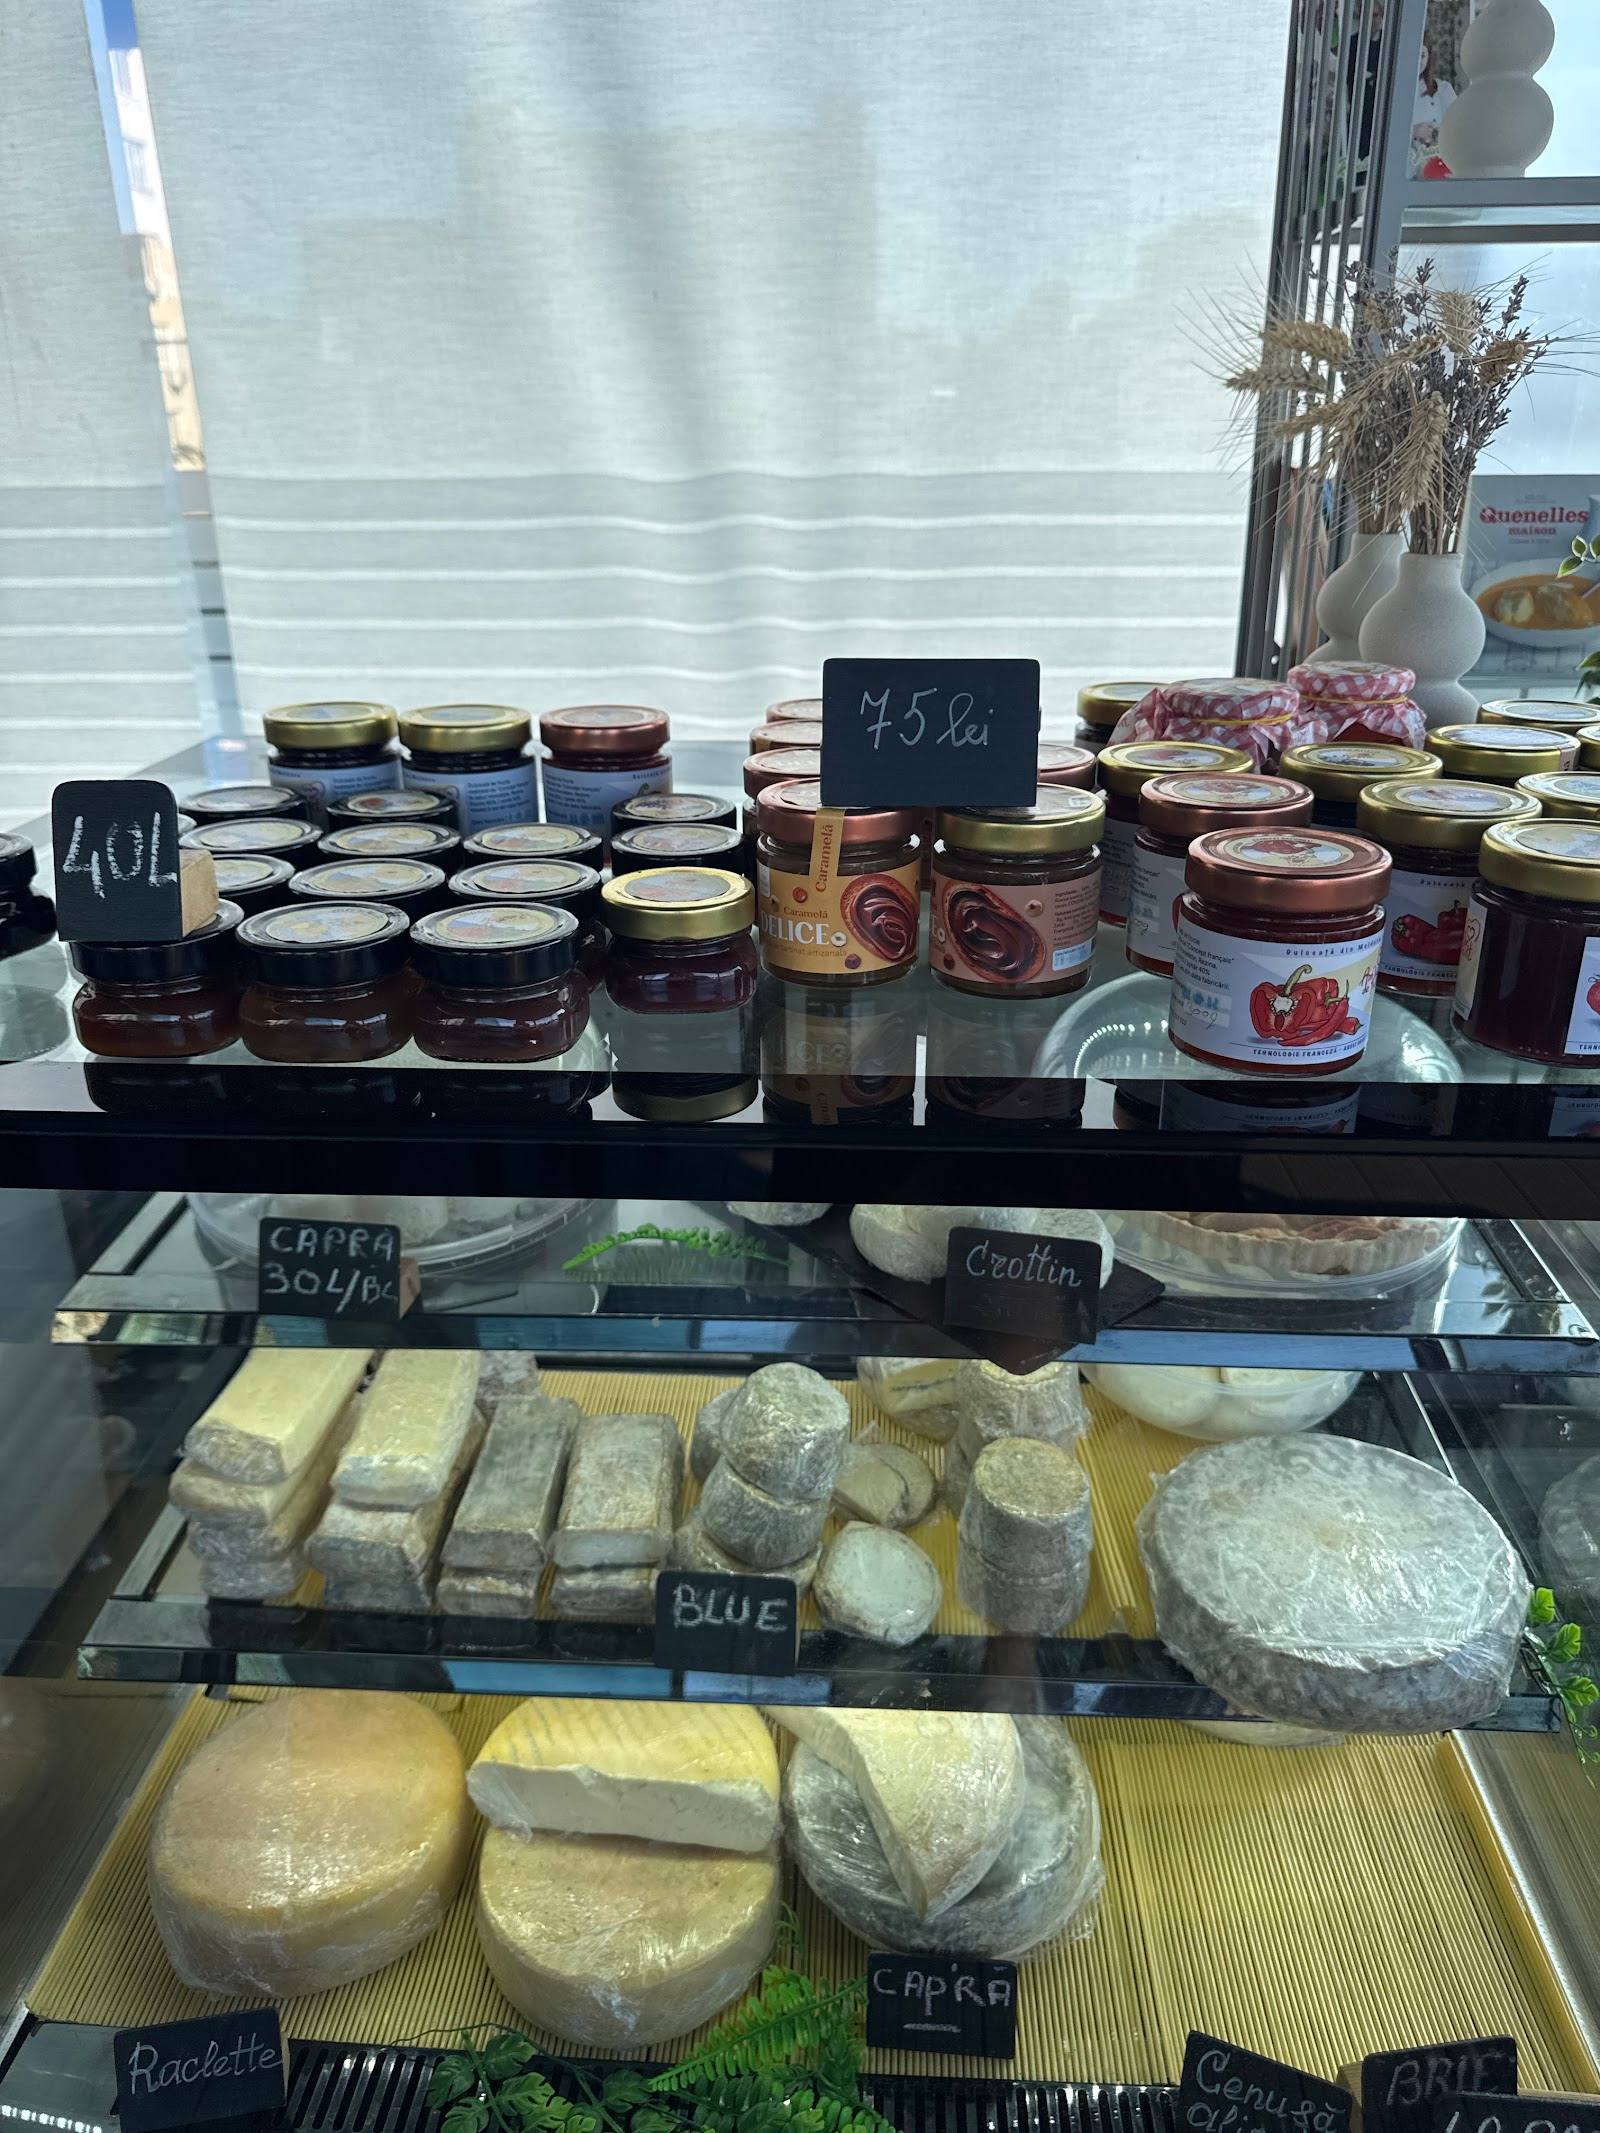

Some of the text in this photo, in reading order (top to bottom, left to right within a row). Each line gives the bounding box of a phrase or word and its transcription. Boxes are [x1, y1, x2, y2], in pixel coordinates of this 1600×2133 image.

[1480, 506, 1589, 523] Quenelles
[1508, 526, 1557, 535] maison
[860, 687, 994, 750] 75 lei
[815, 823, 834, 893] Caramelă
[783, 906, 828, 919] Caramelă
[1253, 1048, 1300, 1057] TEHNOLOGIE
[966, 1240, 1082, 1288] Crottin
[672, 1583, 788, 1632] BLUE
[128, 2032, 282, 2095] Raclette
[1385, 2053, 1506, 2106] BRIE
